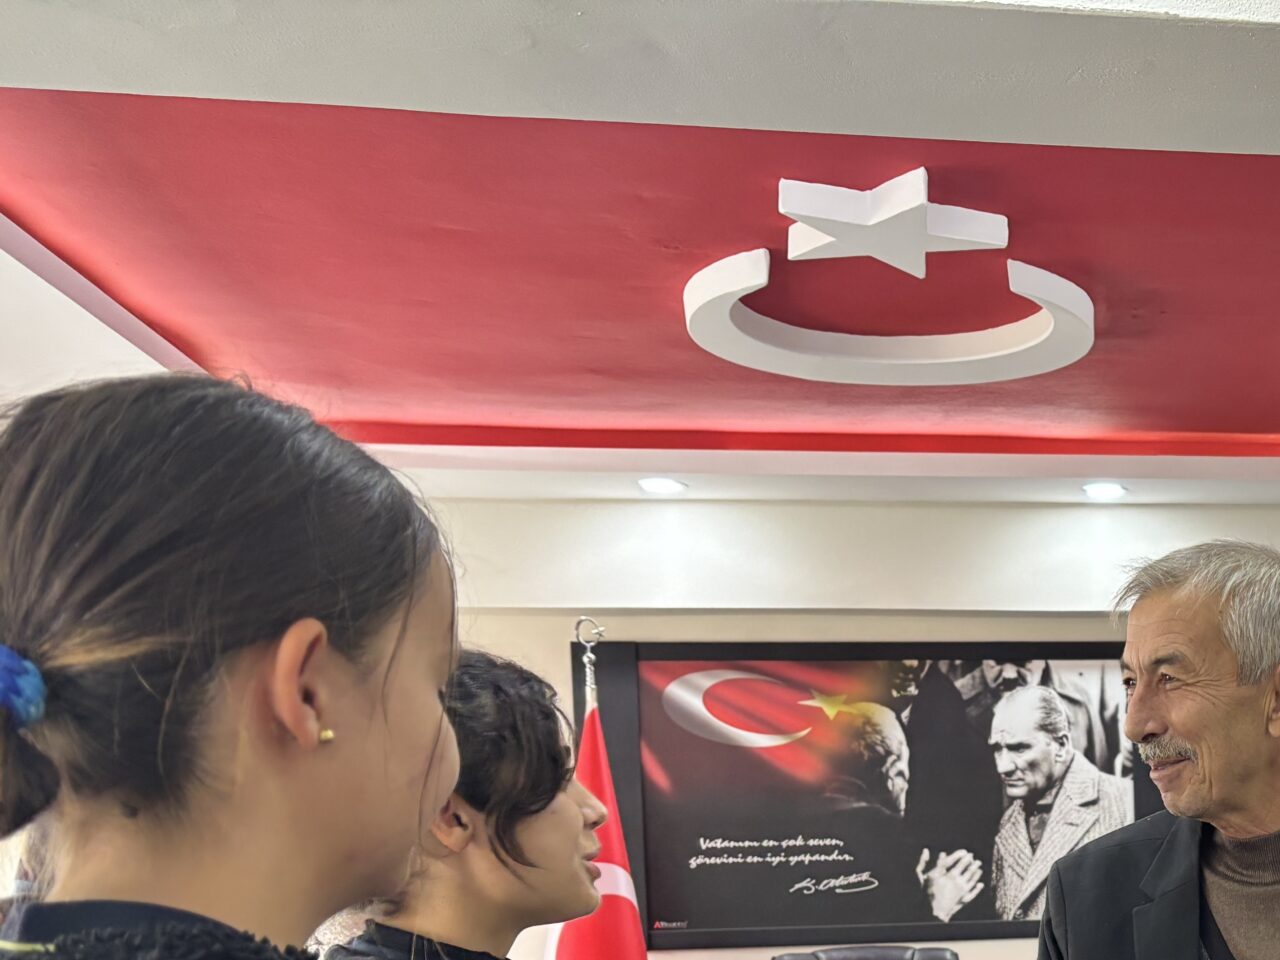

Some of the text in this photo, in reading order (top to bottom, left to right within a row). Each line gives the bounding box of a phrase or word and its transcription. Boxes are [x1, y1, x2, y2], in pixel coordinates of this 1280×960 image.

[762, 839, 779, 847] en
[780, 835, 805, 849] çok
[806, 838, 844, 848] seven,
[688, 853, 744, 869] görevini
[746, 855, 763, 863] en
[764, 853, 786, 867] iyi
